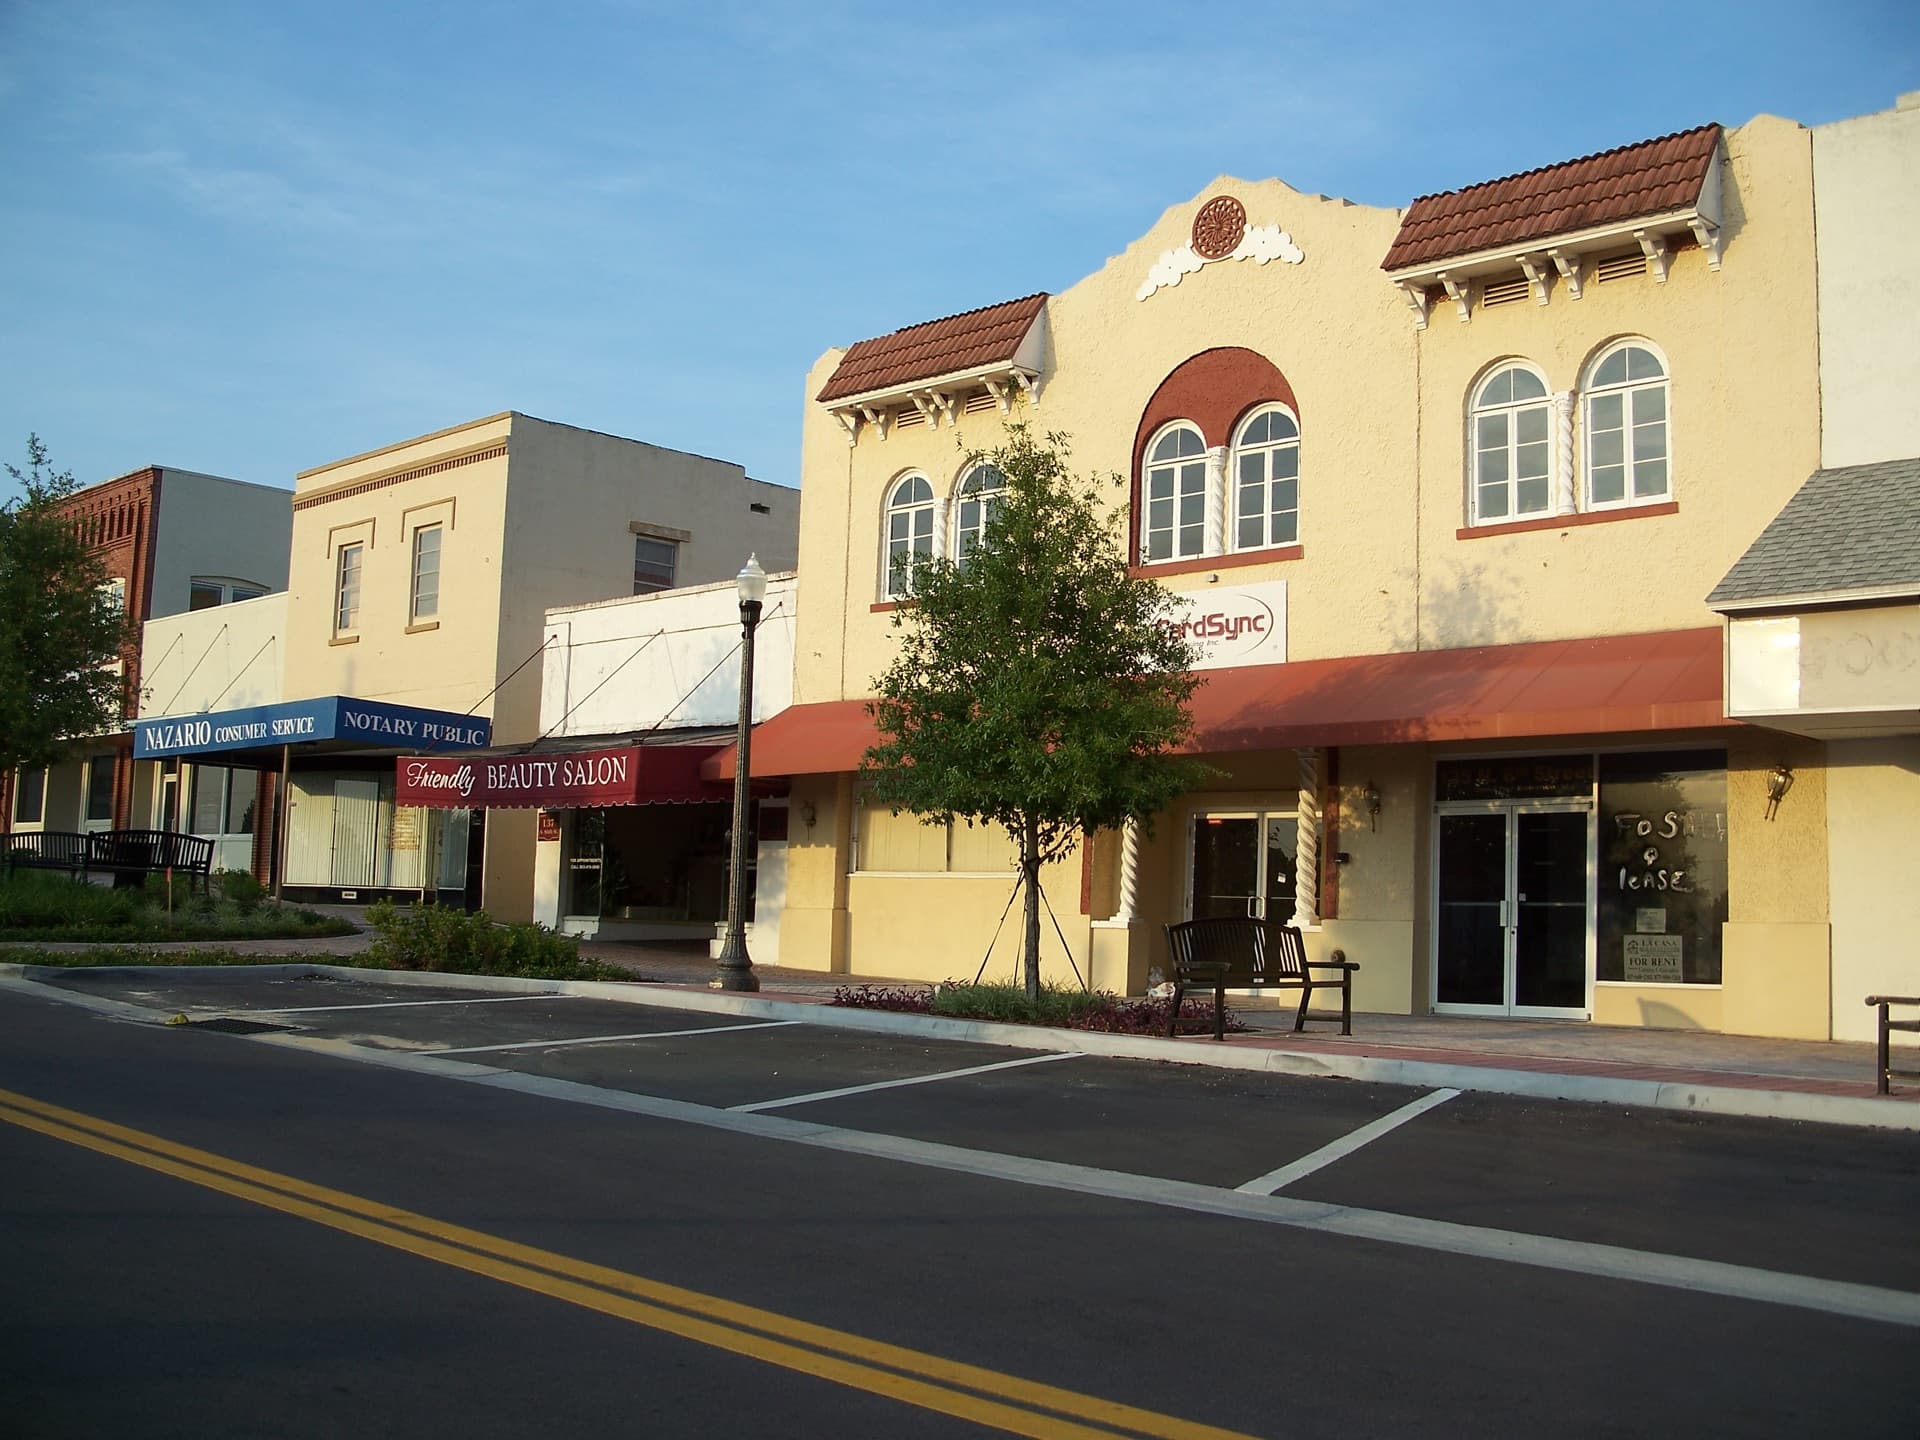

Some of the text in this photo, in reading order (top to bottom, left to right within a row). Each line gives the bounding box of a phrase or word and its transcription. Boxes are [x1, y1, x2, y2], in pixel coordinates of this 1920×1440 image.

[145, 716, 315, 751] NAZARIO CONSUMER SERVICE
[344, 711, 485, 746] NOTARY PUBLIC
[406, 756, 628, 797] Friendly BEAUTY SALON
[1629, 957, 1677, 967] FOR RENT
